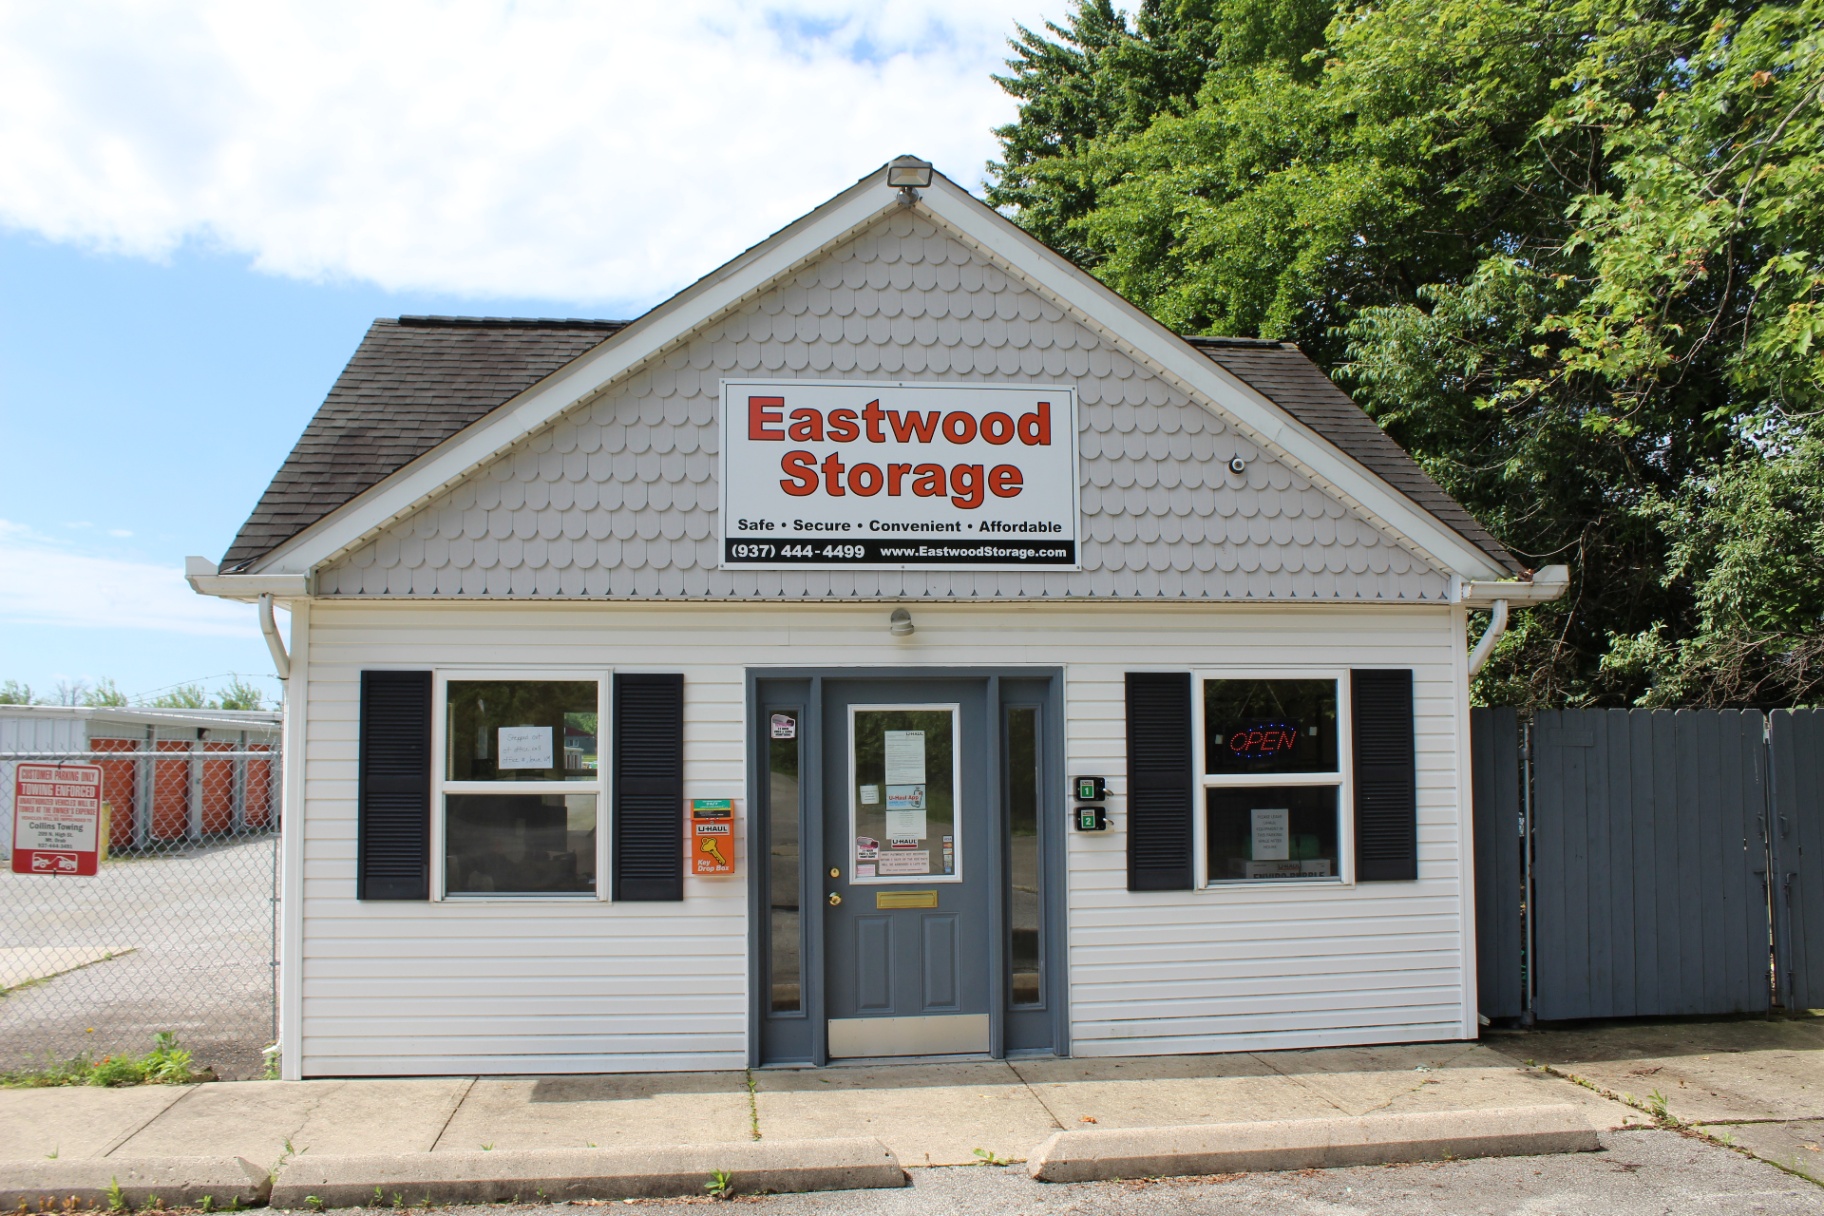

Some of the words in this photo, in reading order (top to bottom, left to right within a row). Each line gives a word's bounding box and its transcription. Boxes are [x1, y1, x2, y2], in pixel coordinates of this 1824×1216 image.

[748, 396, 1051, 445] Eastwood
[780, 450, 1024, 509] Storage
[738, 519, 775, 532] Safe
[793, 520, 851, 532] Secure
[869, 520, 960, 533] Convenient
[979, 521, 1062, 533] Affordable
[731, 544, 776, 560] (937)
[781, 545, 865, 559] 444-4499
[880, 545, 1067, 560] www.EastwoodStorage.com
[1230, 731, 1297, 751] OPEN
[22, 769, 52, 779] CUSTOMER
[54, 771, 79, 782] PARKING
[81, 772, 95, 782] ONLY
[21, 783, 54, 796] TOWING
[55, 785, 96, 798] ENFORCED
[1085, 787, 1089, 795] 1
[29, 822, 56, 830] Collins
[57, 823, 83, 833] Towing
[1085, 817, 1091, 825] 2
